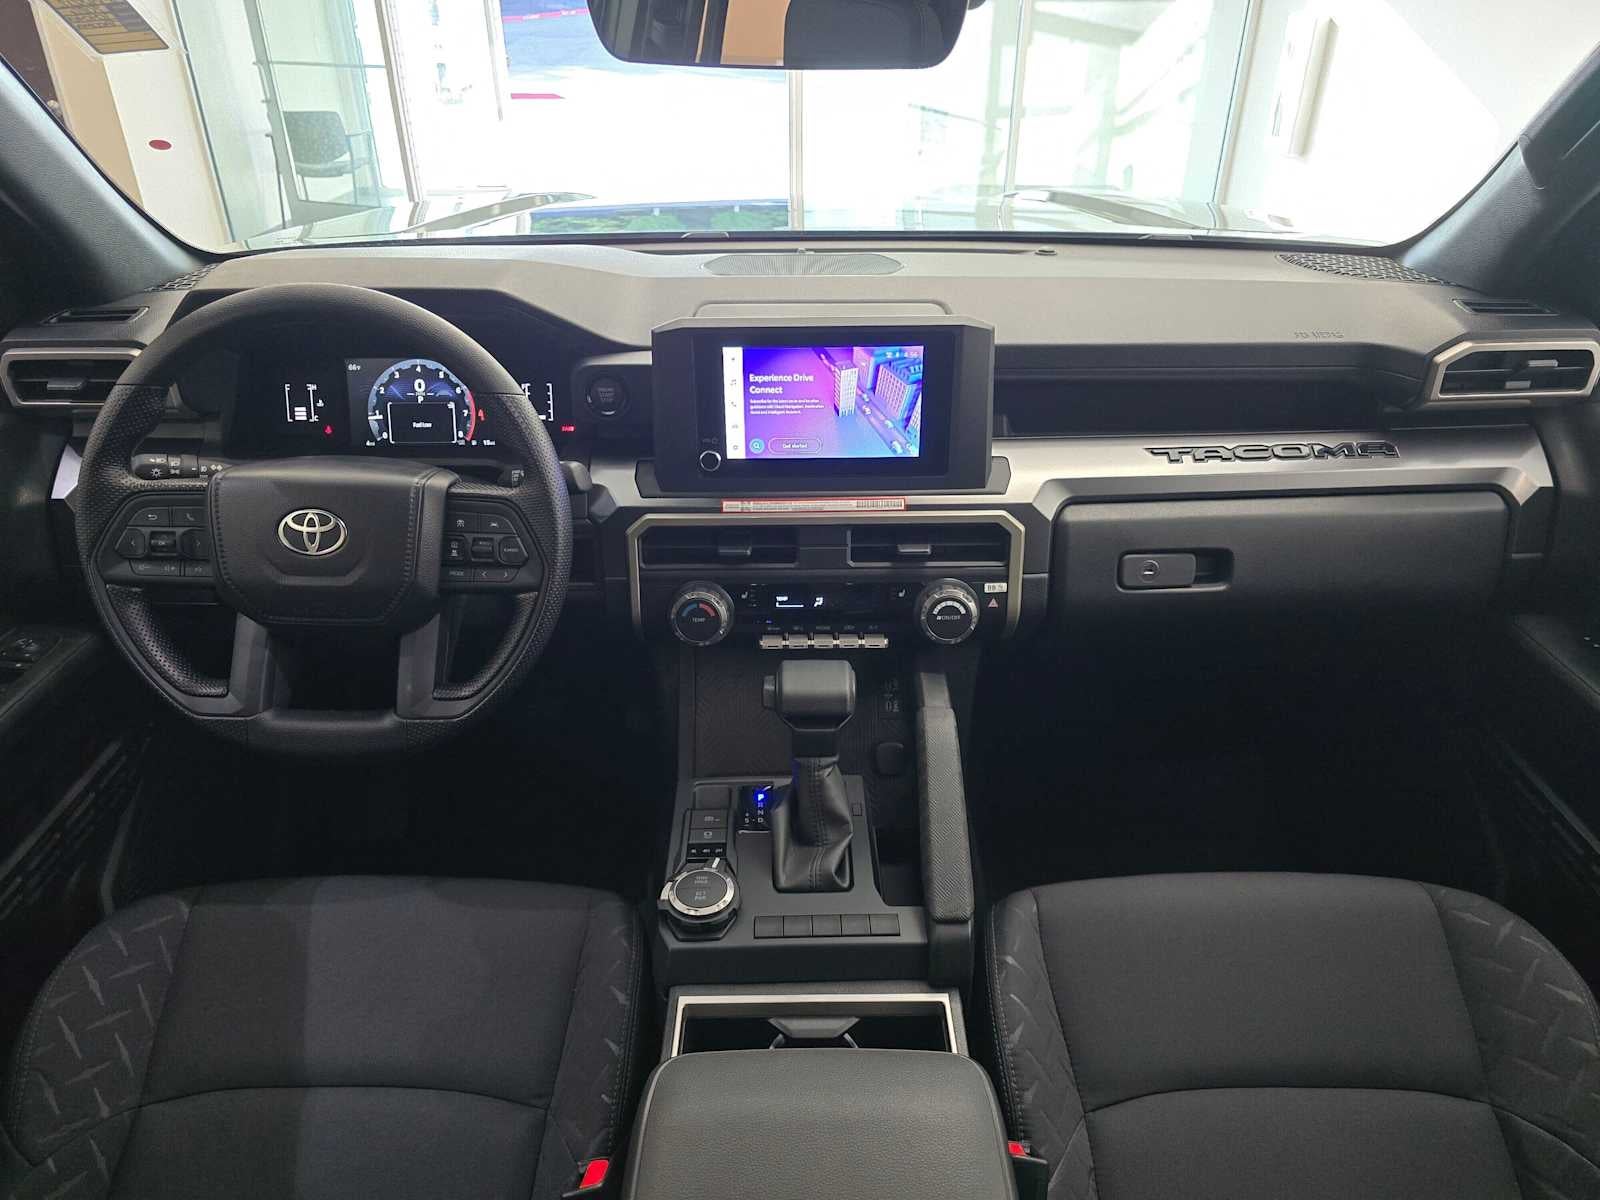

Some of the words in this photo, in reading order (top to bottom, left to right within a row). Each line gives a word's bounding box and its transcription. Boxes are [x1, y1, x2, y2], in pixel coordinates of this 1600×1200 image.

[749, 374, 793, 384] Experience
[793, 374, 815, 383] Drive
[413, 378, 426, 393] 0
[749, 386, 784, 395] Connect
[1144, 439, 1400, 464] TACOMA
